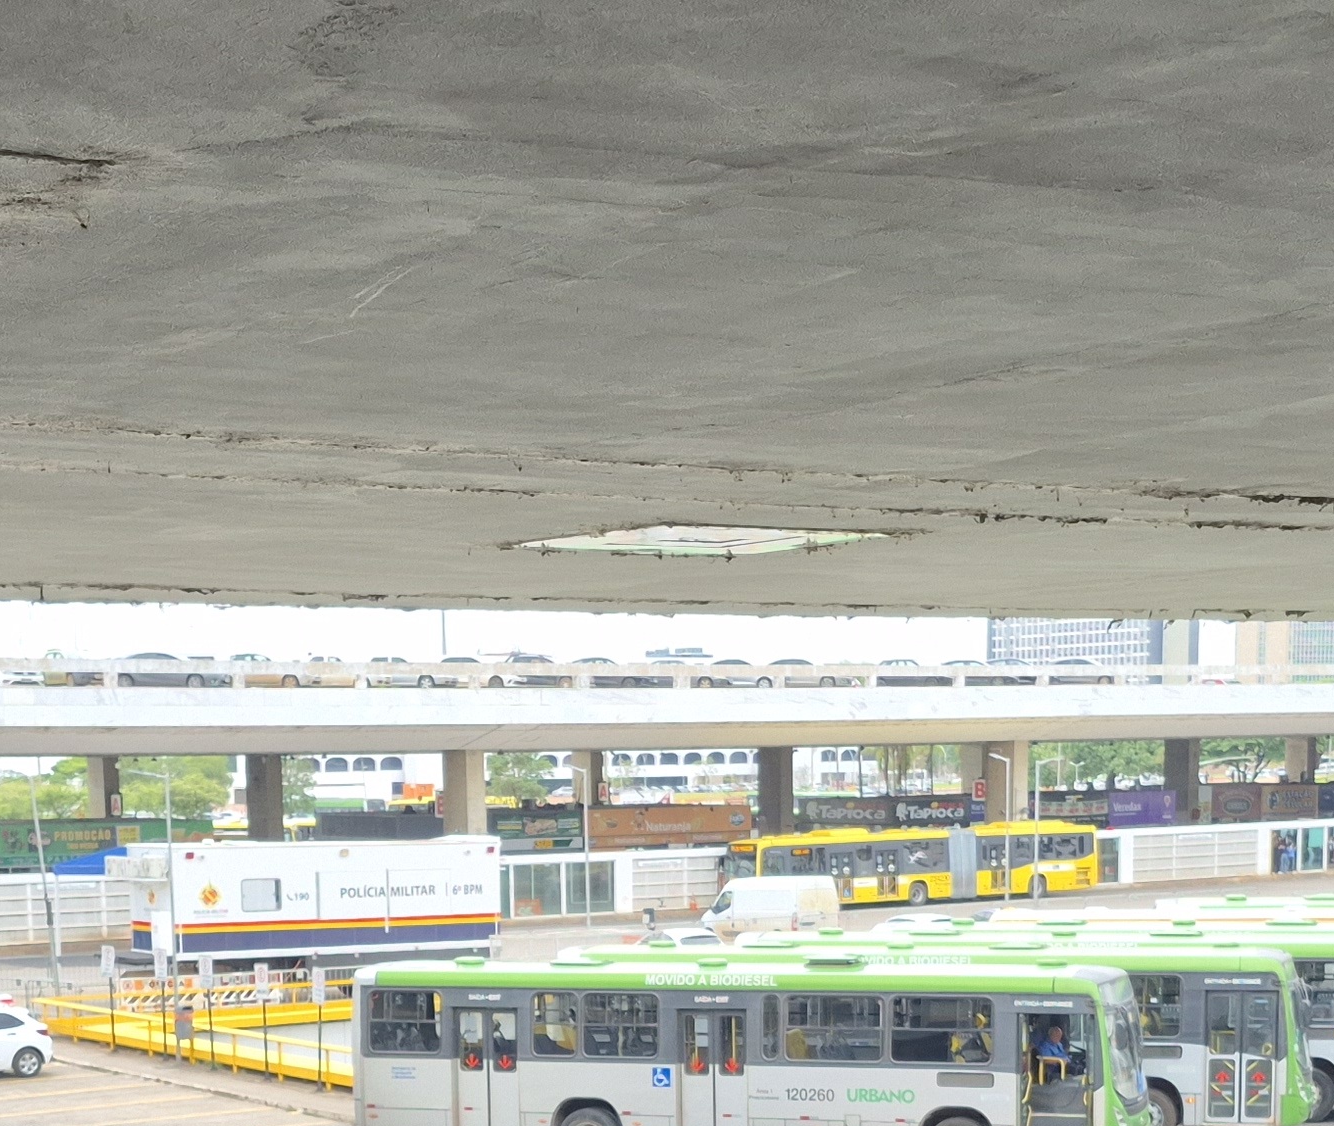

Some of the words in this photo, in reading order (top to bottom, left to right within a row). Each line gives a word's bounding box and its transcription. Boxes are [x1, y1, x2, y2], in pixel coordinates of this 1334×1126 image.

[599, 784, 608, 800] A
[975, 782, 986, 799] B
[819, 803, 886, 820] Tapioca
[907, 803, 965, 820] Tapioca
[294, 892, 310, 901] 190
[339, 880, 386, 899] POLÍCIA
[390, 884, 436, 897] MILITAR
[463, 884, 483, 896] BPM
[645, 973, 696, 987] MOVIDO
[697, 975, 708, 987] A
[709, 974, 778, 987] BIODIESEL
[785, 1088, 836, 1102] 120260
[846, 1088, 916, 1104] URBANO
